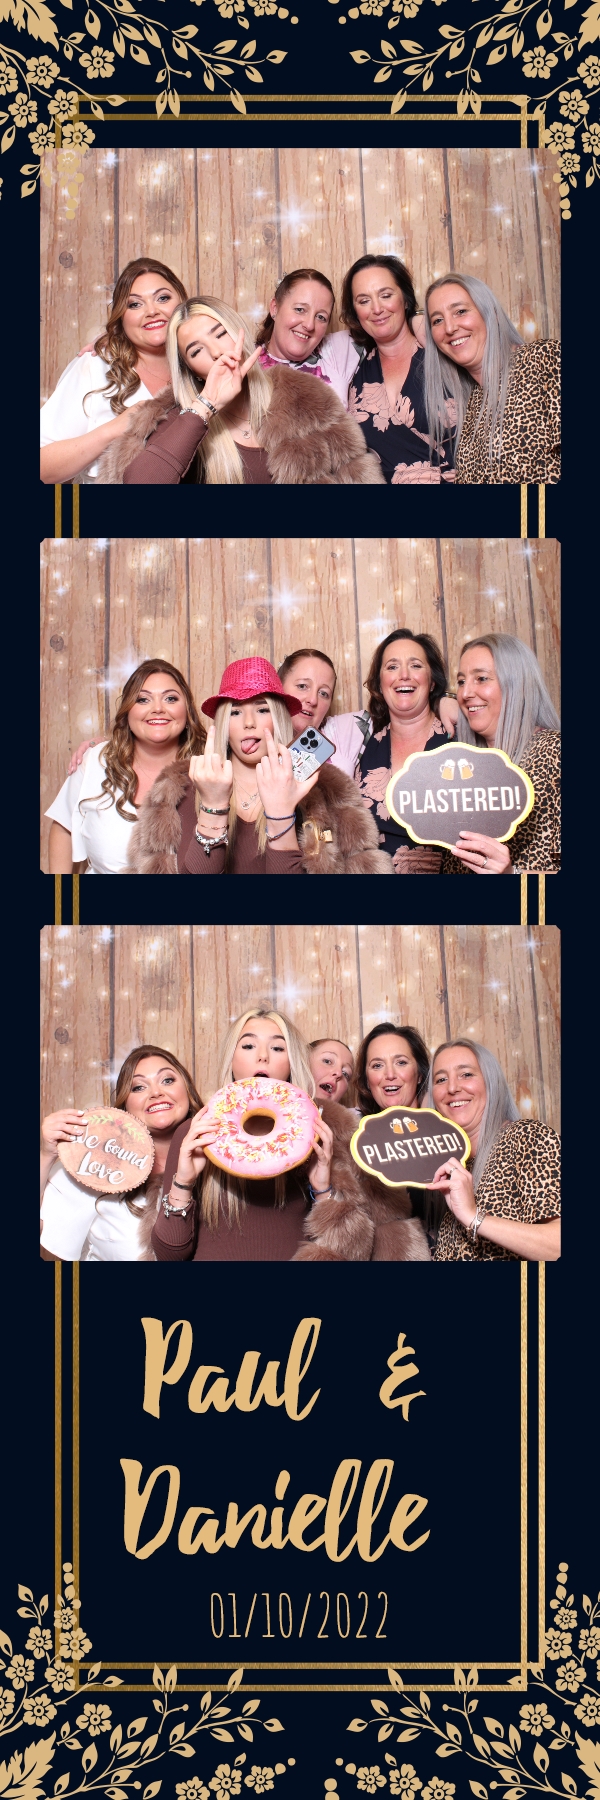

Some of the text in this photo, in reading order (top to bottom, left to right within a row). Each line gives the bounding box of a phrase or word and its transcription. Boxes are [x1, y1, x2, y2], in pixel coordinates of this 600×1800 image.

[399, 786, 521, 814] PLASTERED!
[104, 1138, 149, 1170] found
[362, 1132, 463, 1165] PLASTERED!
[76, 1151, 126, 1185] Love
